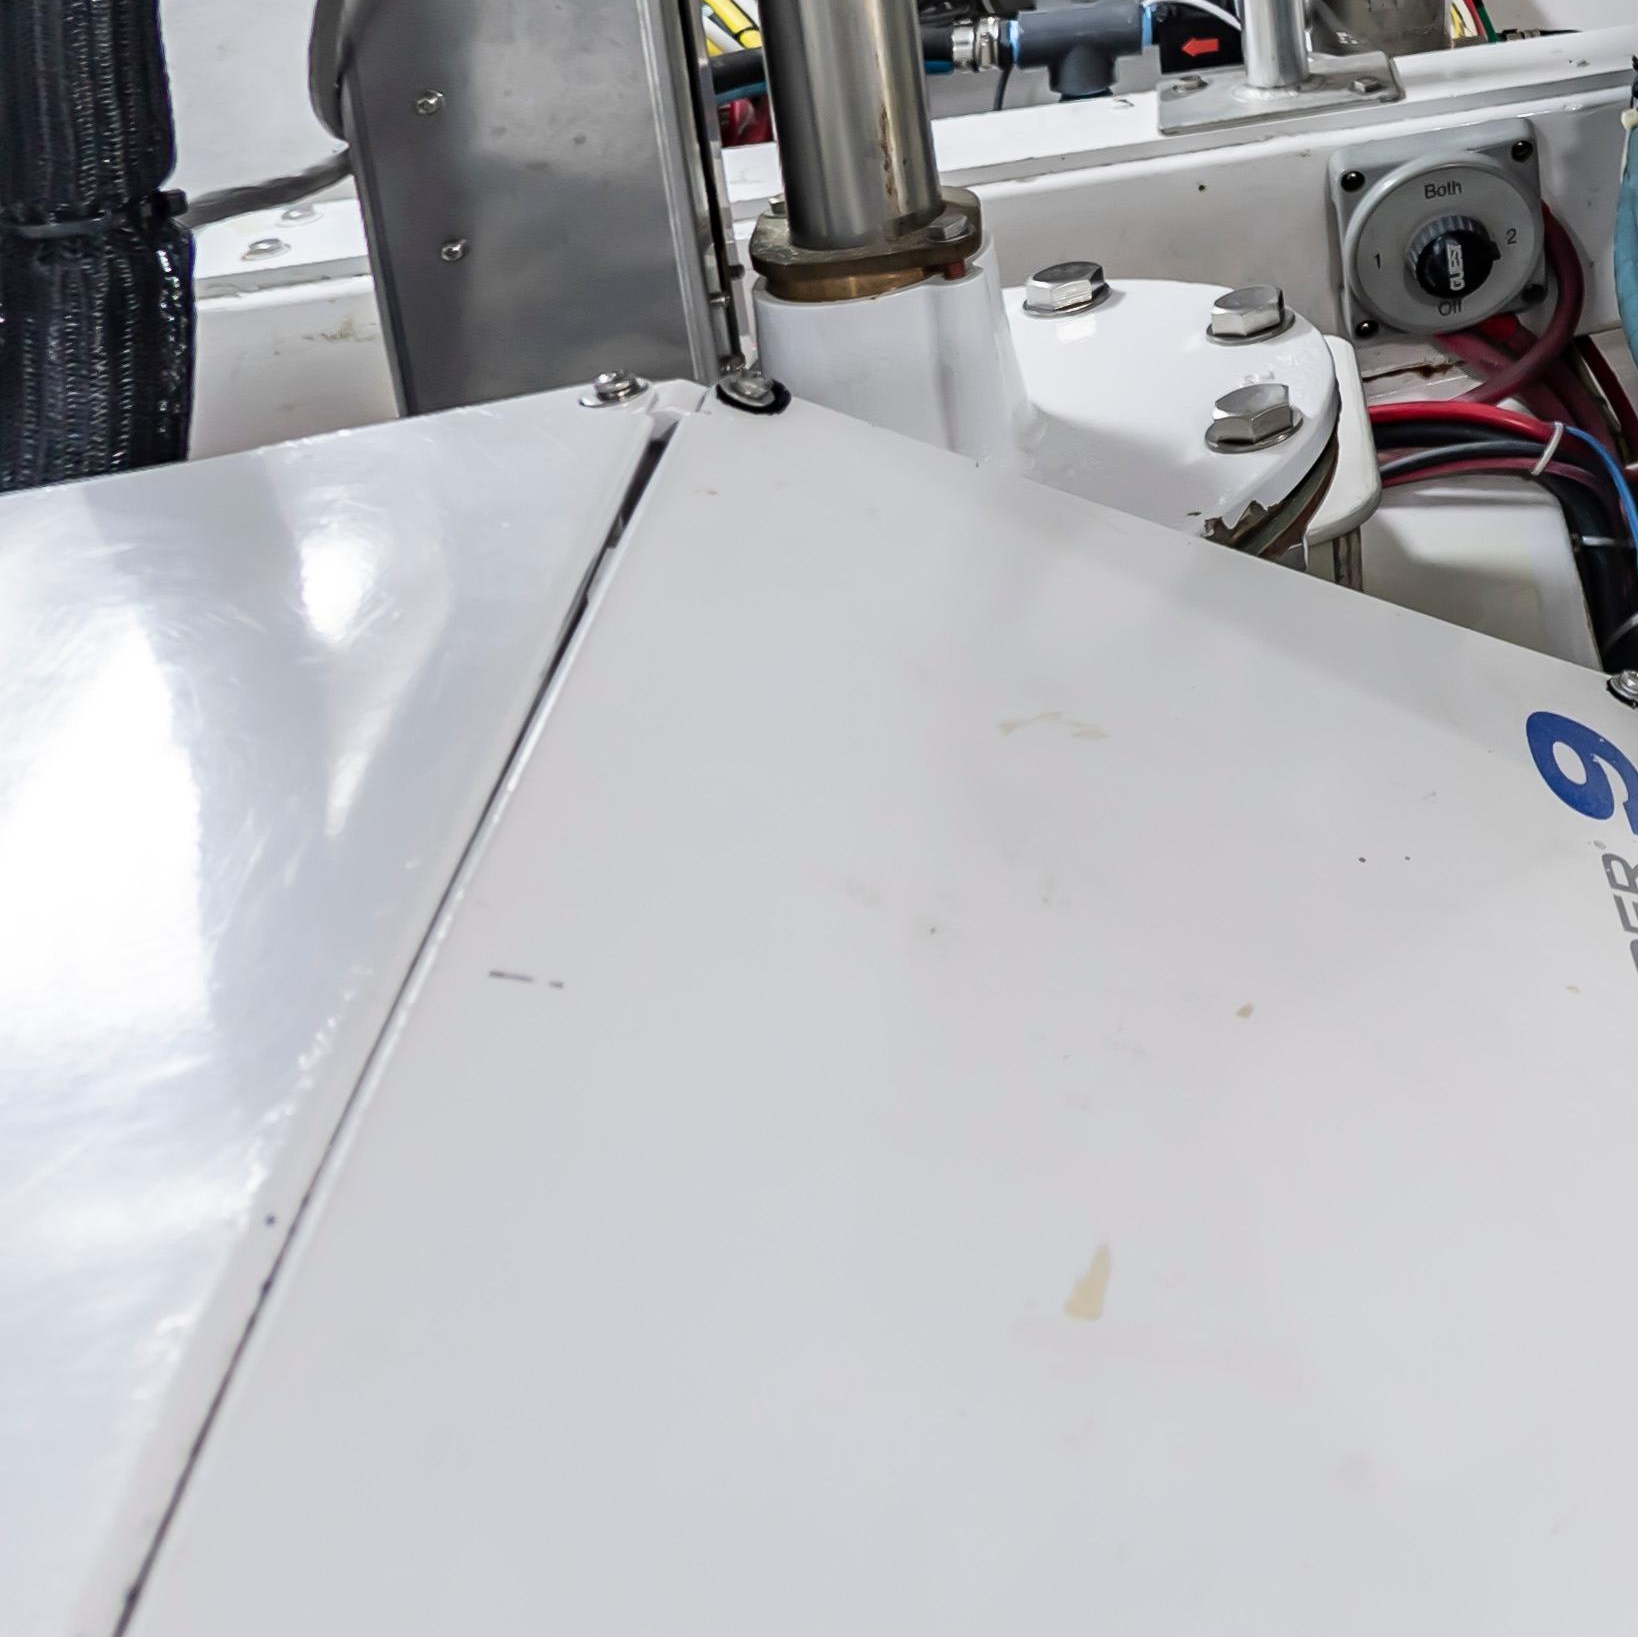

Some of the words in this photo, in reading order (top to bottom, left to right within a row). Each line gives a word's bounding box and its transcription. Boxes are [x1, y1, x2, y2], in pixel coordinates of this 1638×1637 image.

[1424, 180, 1462, 199] Both
[1506, 228, 1517, 245] 2
[1373, 253, 1382, 270] 1
[1438, 299, 1462, 316] Off
